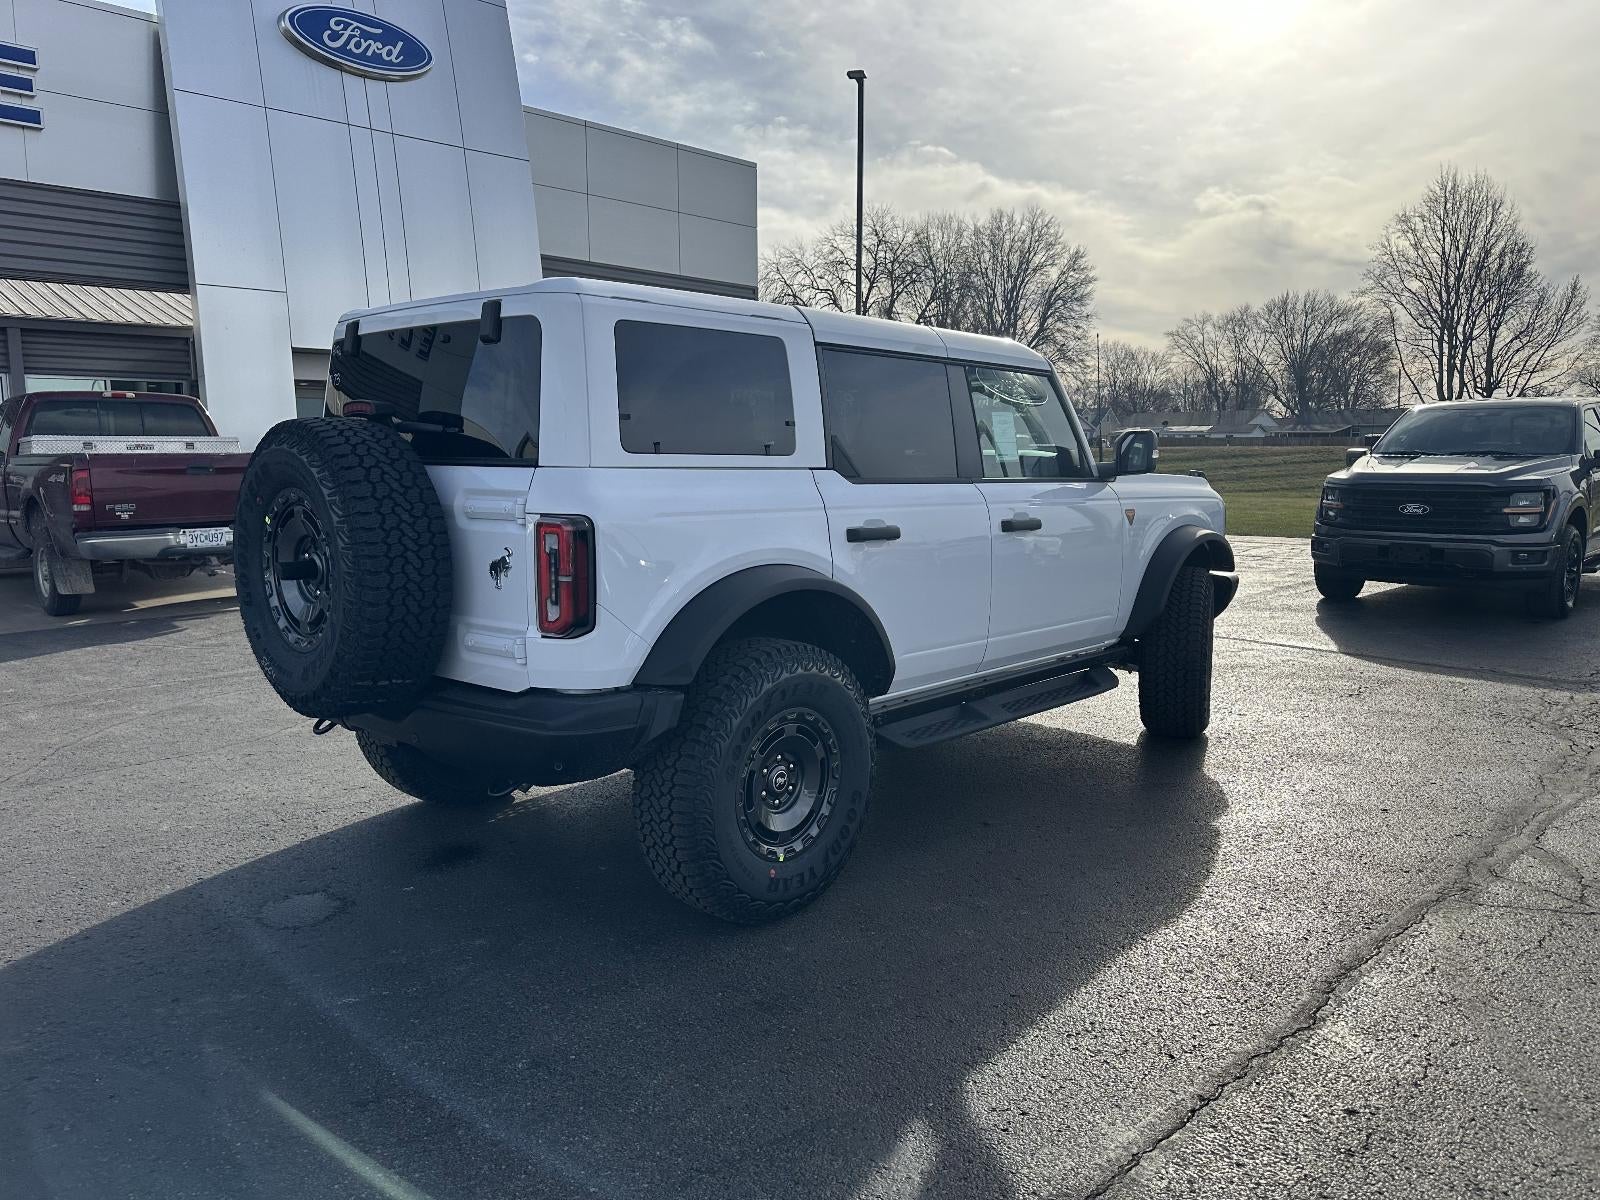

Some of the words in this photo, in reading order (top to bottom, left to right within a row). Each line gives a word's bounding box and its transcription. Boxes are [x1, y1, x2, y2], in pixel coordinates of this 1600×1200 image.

[323, 17, 404, 63] Ford
[1403, 504, 1424, 515] Ford
[189, 533, 205, 543] 3YC
[208, 532, 224, 542] U97
[766, 789, 862, 894] GOODYEAR
